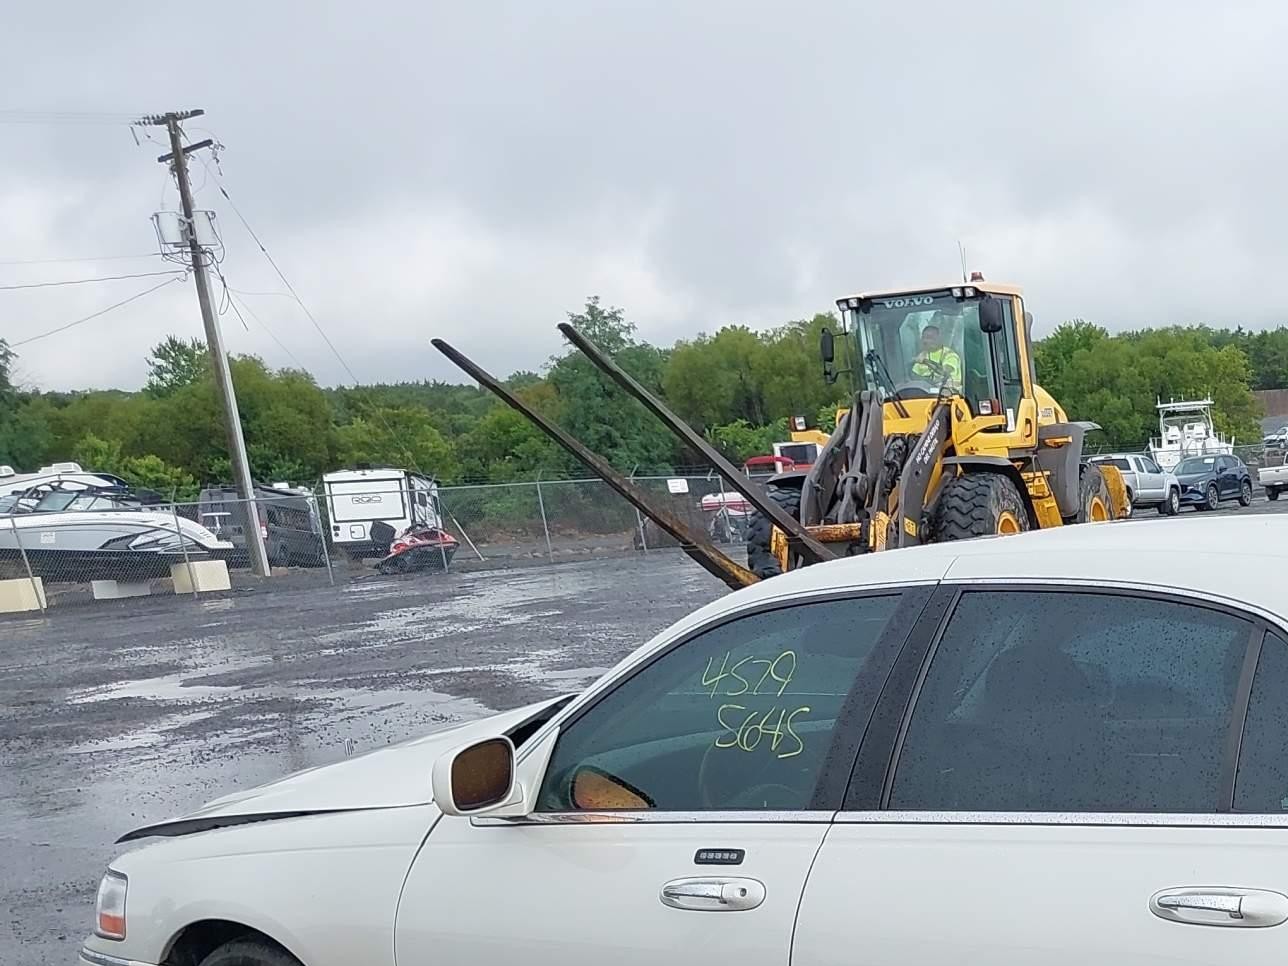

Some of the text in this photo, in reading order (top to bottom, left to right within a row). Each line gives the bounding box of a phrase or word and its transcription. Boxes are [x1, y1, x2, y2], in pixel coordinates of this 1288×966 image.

[883, 296, 934, 309] VOLVO
[702, 651, 796, 699] 4579
[715, 704, 810, 758] 5645
